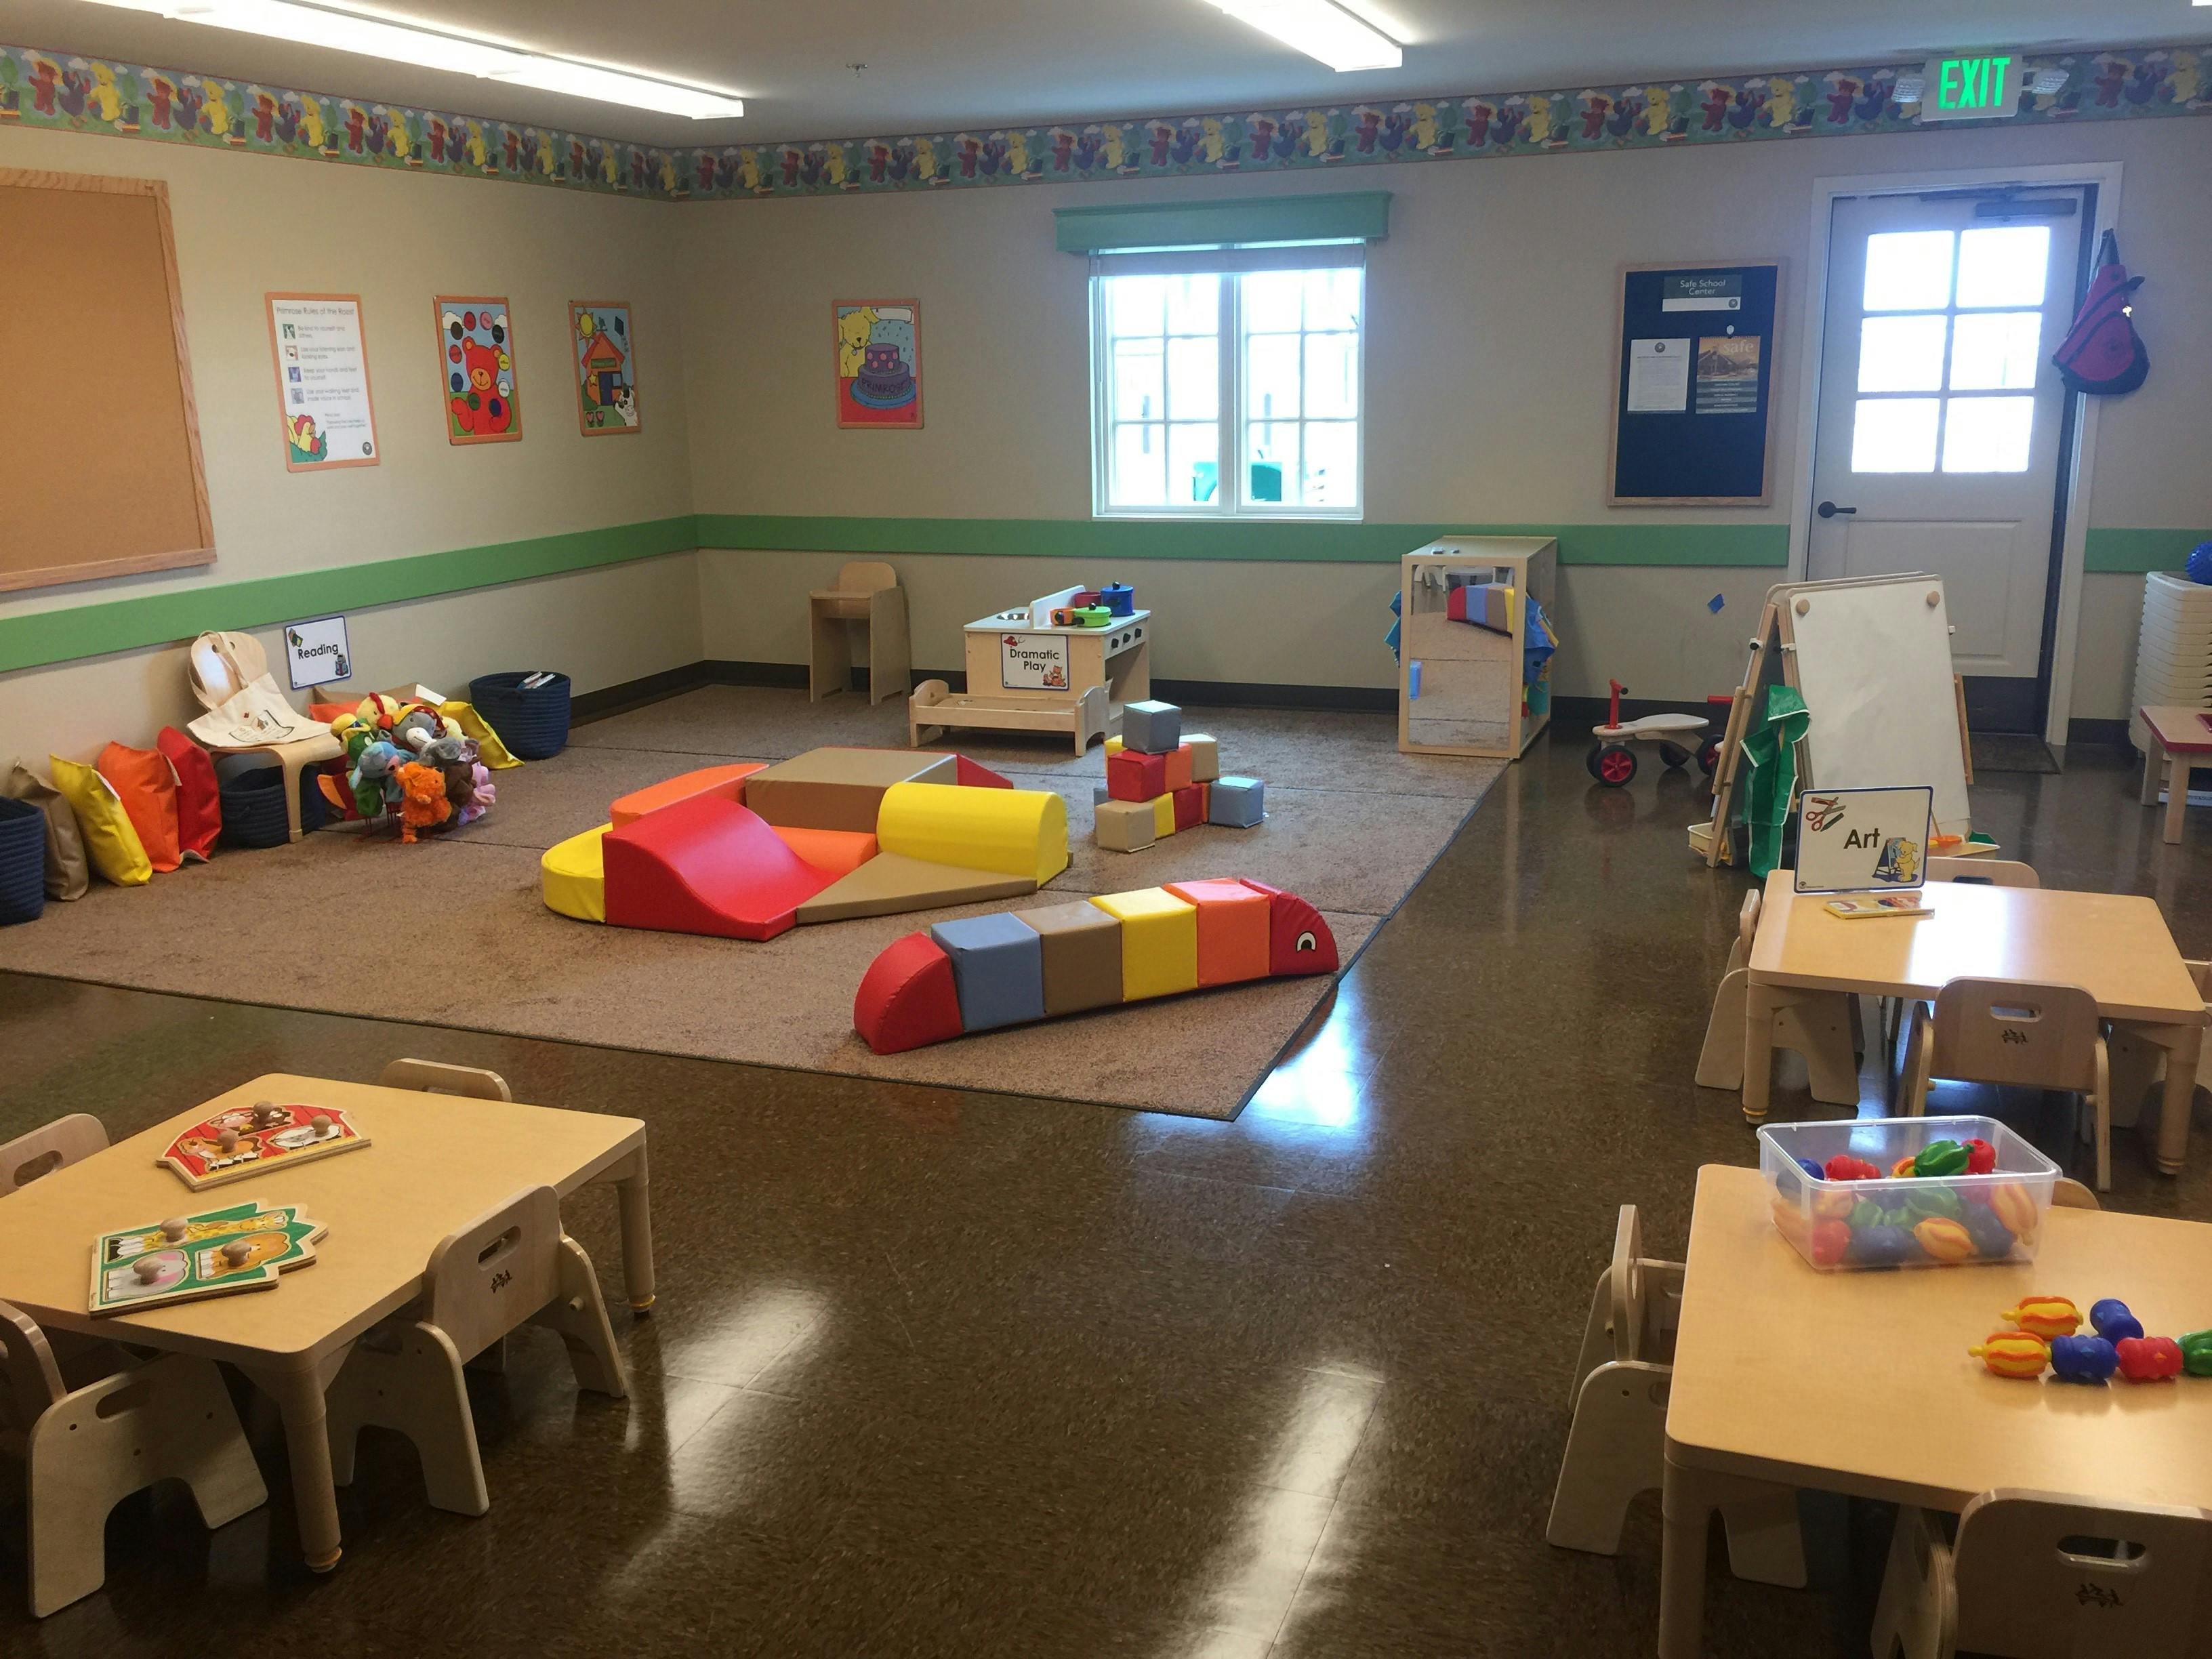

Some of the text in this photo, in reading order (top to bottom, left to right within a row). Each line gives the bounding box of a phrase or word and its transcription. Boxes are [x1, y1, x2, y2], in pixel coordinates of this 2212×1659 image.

[1938, 57, 2011, 109] EXIT
[1680, 279, 1726, 288] Safe School
[1688, 287, 1716, 295] Center
[276, 307, 302, 315] Primrose
[303, 307, 319, 315] Rules
[1723, 340, 1753, 353] safe
[298, 643, 339, 660] Reading
[1010, 649, 1060, 659] Dramatic
[1023, 660, 1046, 673] Play
[1843, 827, 1881, 849] Art
